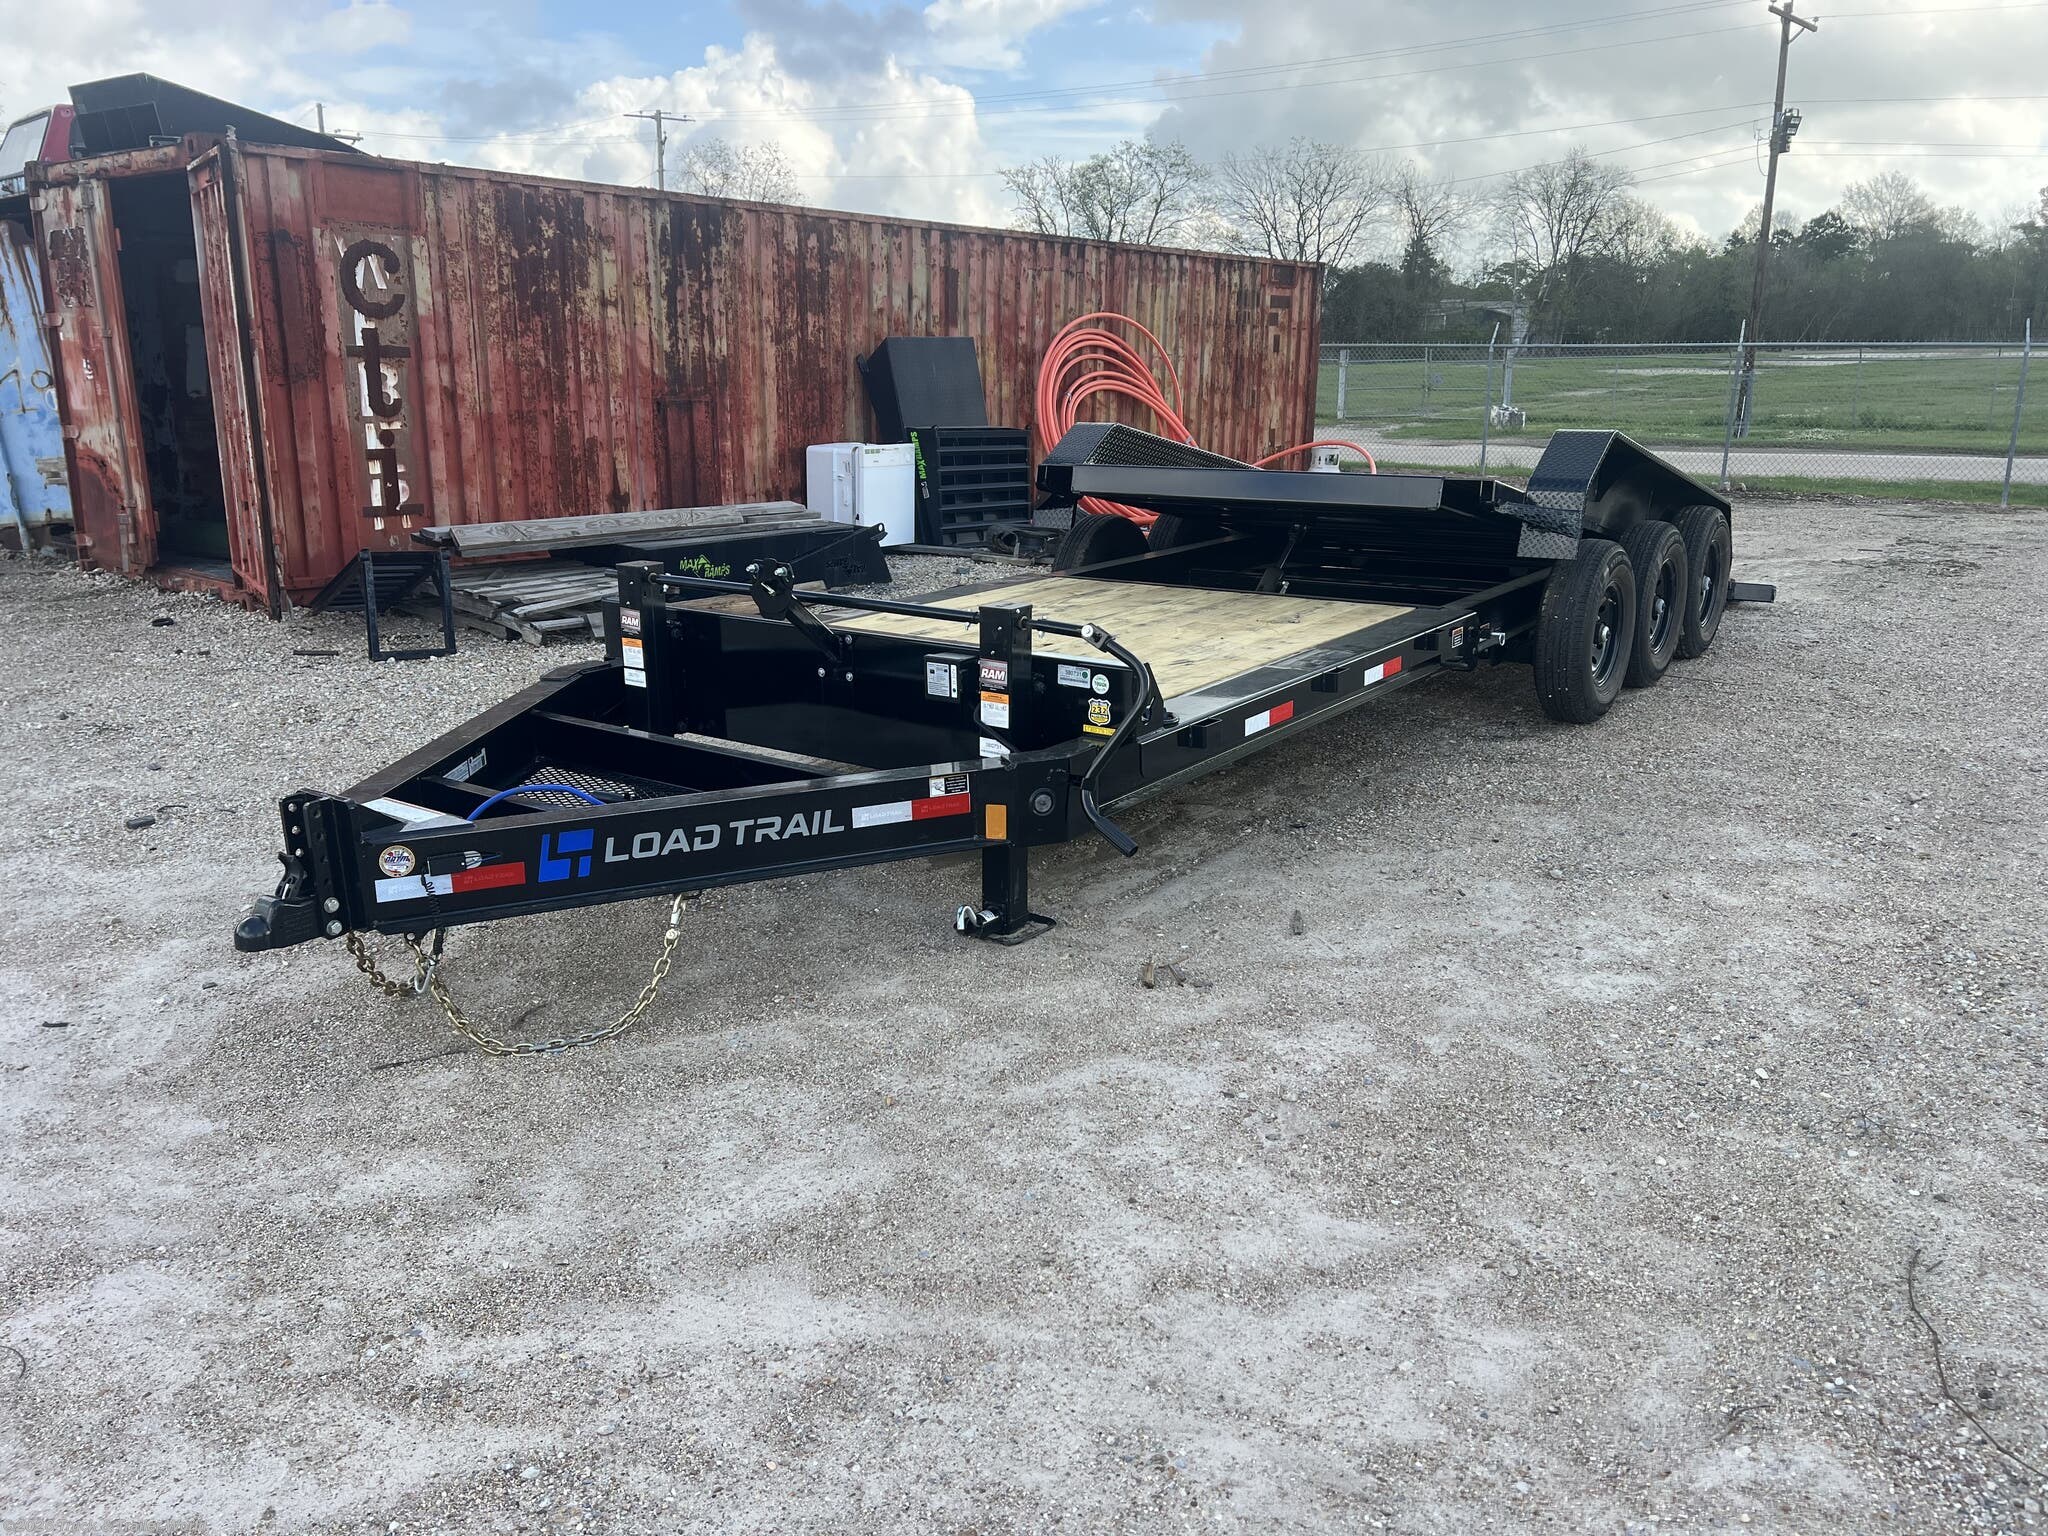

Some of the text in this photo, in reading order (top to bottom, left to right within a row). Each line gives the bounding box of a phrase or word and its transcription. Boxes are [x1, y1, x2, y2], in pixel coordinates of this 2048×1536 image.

[679, 556, 731, 578] MAX RAMPS
[621, 615, 639, 627] RAM
[980, 667, 1006, 681] RAM
[604, 824, 721, 863] LOAD
[729, 809, 844, 846] TRAIL
